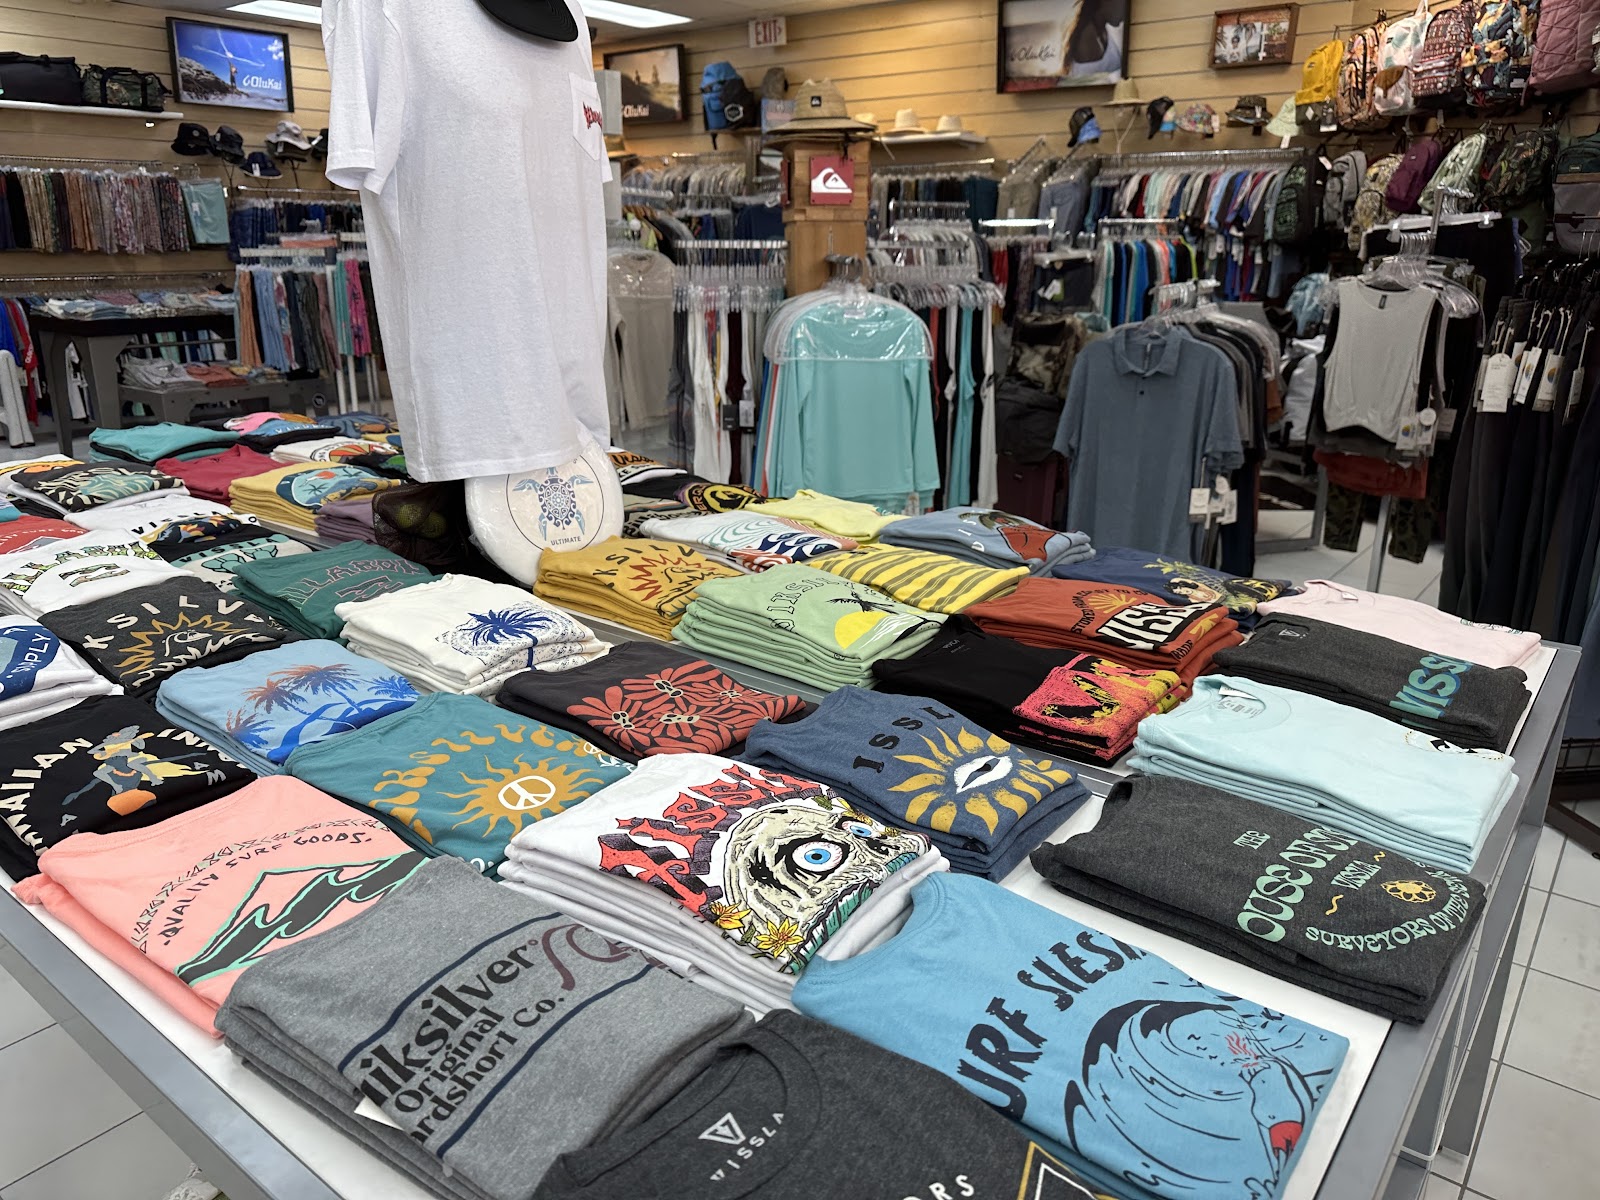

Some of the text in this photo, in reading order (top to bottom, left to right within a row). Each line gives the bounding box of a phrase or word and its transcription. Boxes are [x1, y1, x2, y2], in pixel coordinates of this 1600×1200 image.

[755, 20, 777, 44] EXIT
[250, 76, 282, 90] OluKai
[181, 537, 279, 563] VISSLA
[550, 536, 582, 546] ULTIMATE
[1389, 653, 1474, 719] VISS
[1232, 830, 1271, 850] THE
[1278, 839, 1338, 869] OF
[1330, 859, 1382, 891] VISSLA
[1428, 911, 1457, 932] OF
[1442, 893, 1469, 923] THE
[1304, 918, 1437, 953] SURVEYORS
[512, 996, 566, 1028] Co.
[394, 1005, 506, 1113] Original
[710, 1111, 785, 1182] VISSLA
